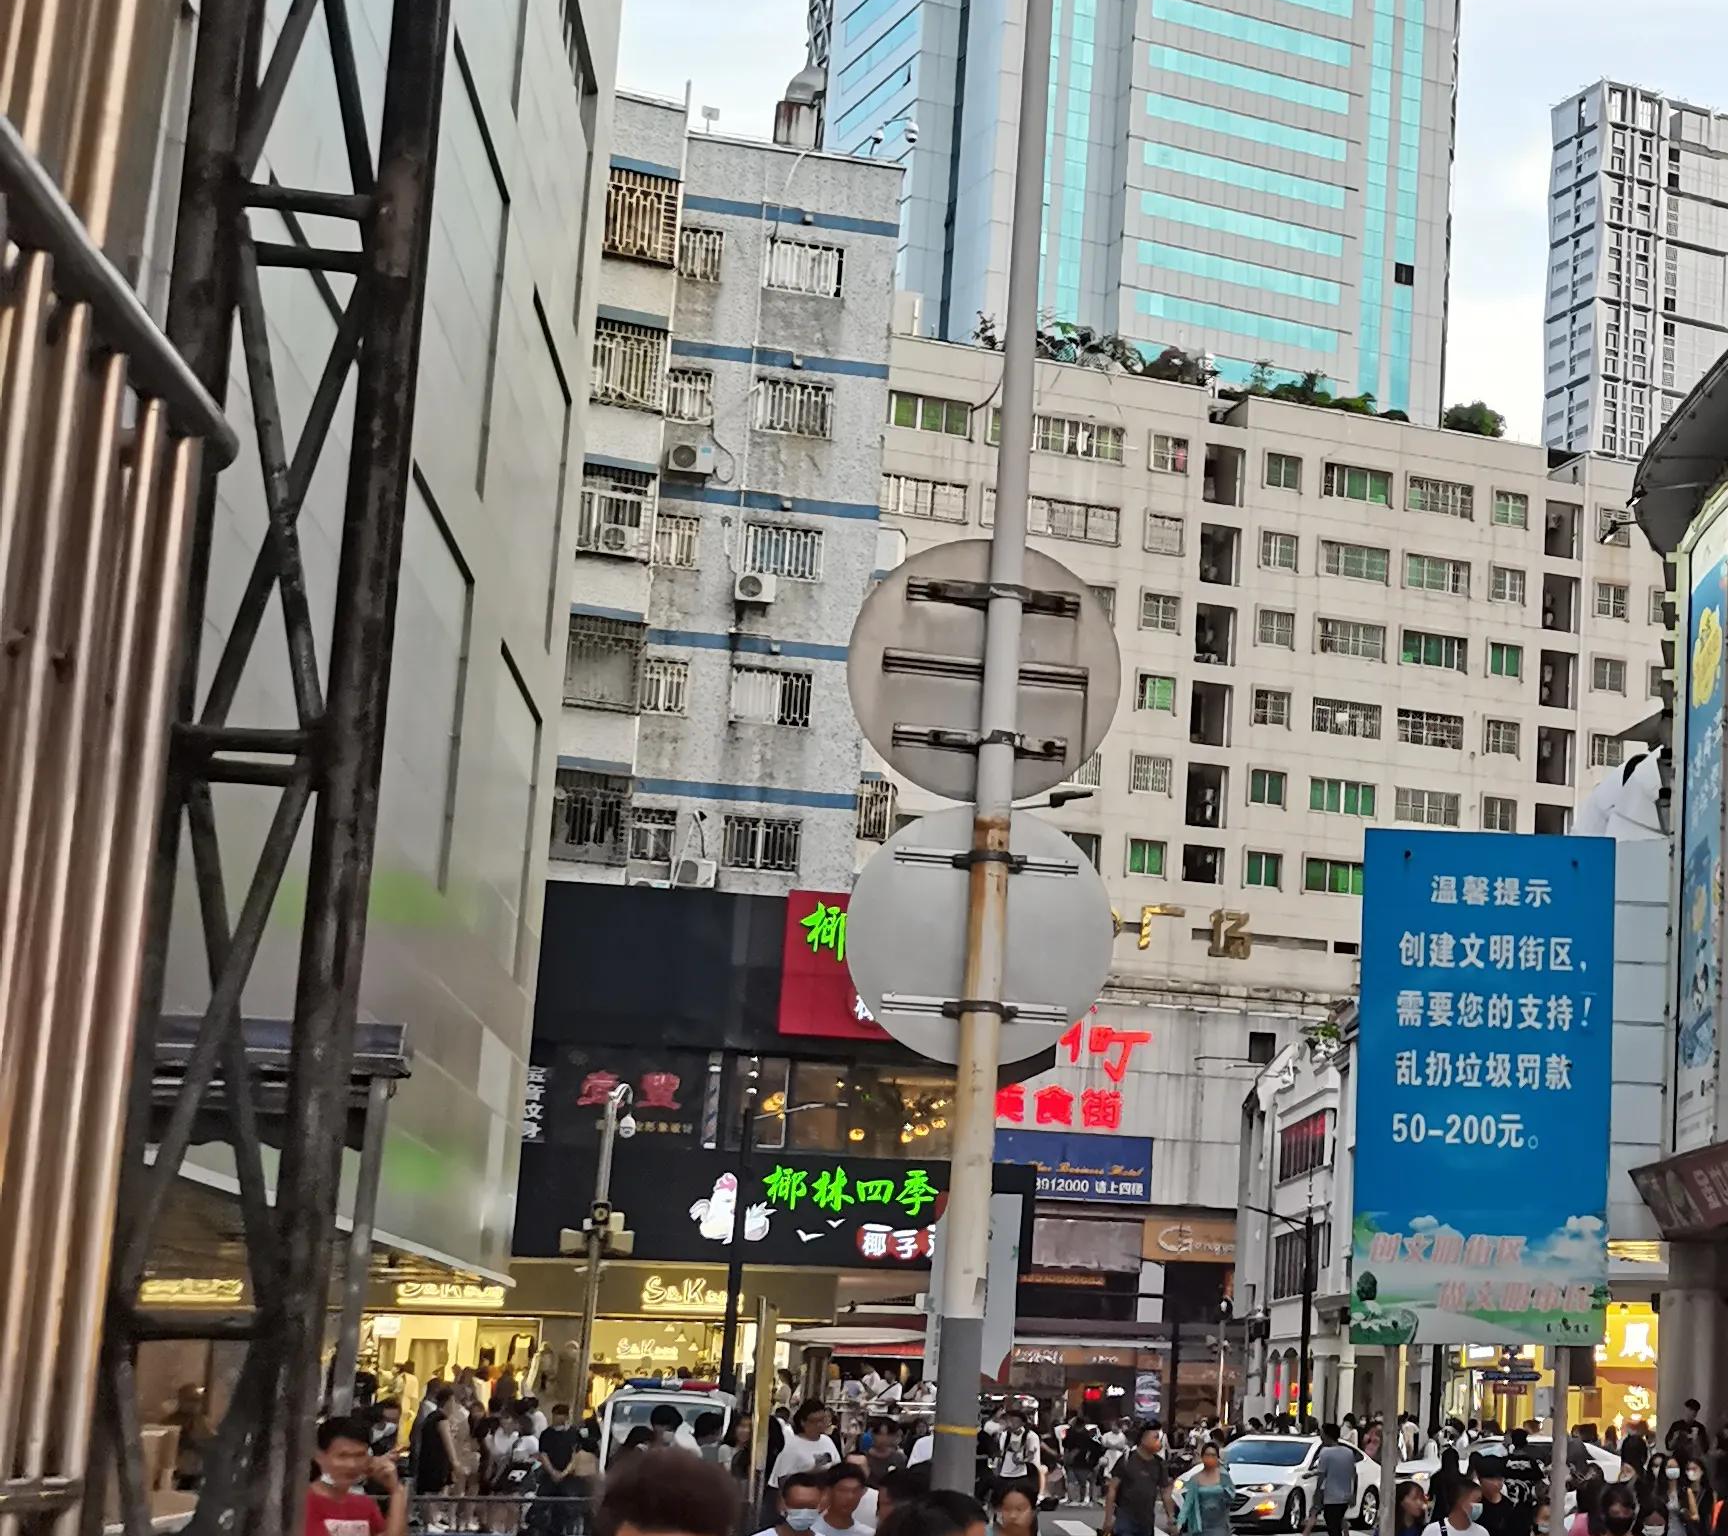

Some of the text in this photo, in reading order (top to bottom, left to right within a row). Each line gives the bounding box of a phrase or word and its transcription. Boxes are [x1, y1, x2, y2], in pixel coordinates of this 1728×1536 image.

[1431, 874, 1553, 907] 温馨提示
[1395, 1052, 1574, 1091] 乱扔垃圾罚款
[762, 1164, 940, 1216] 椰林四季
